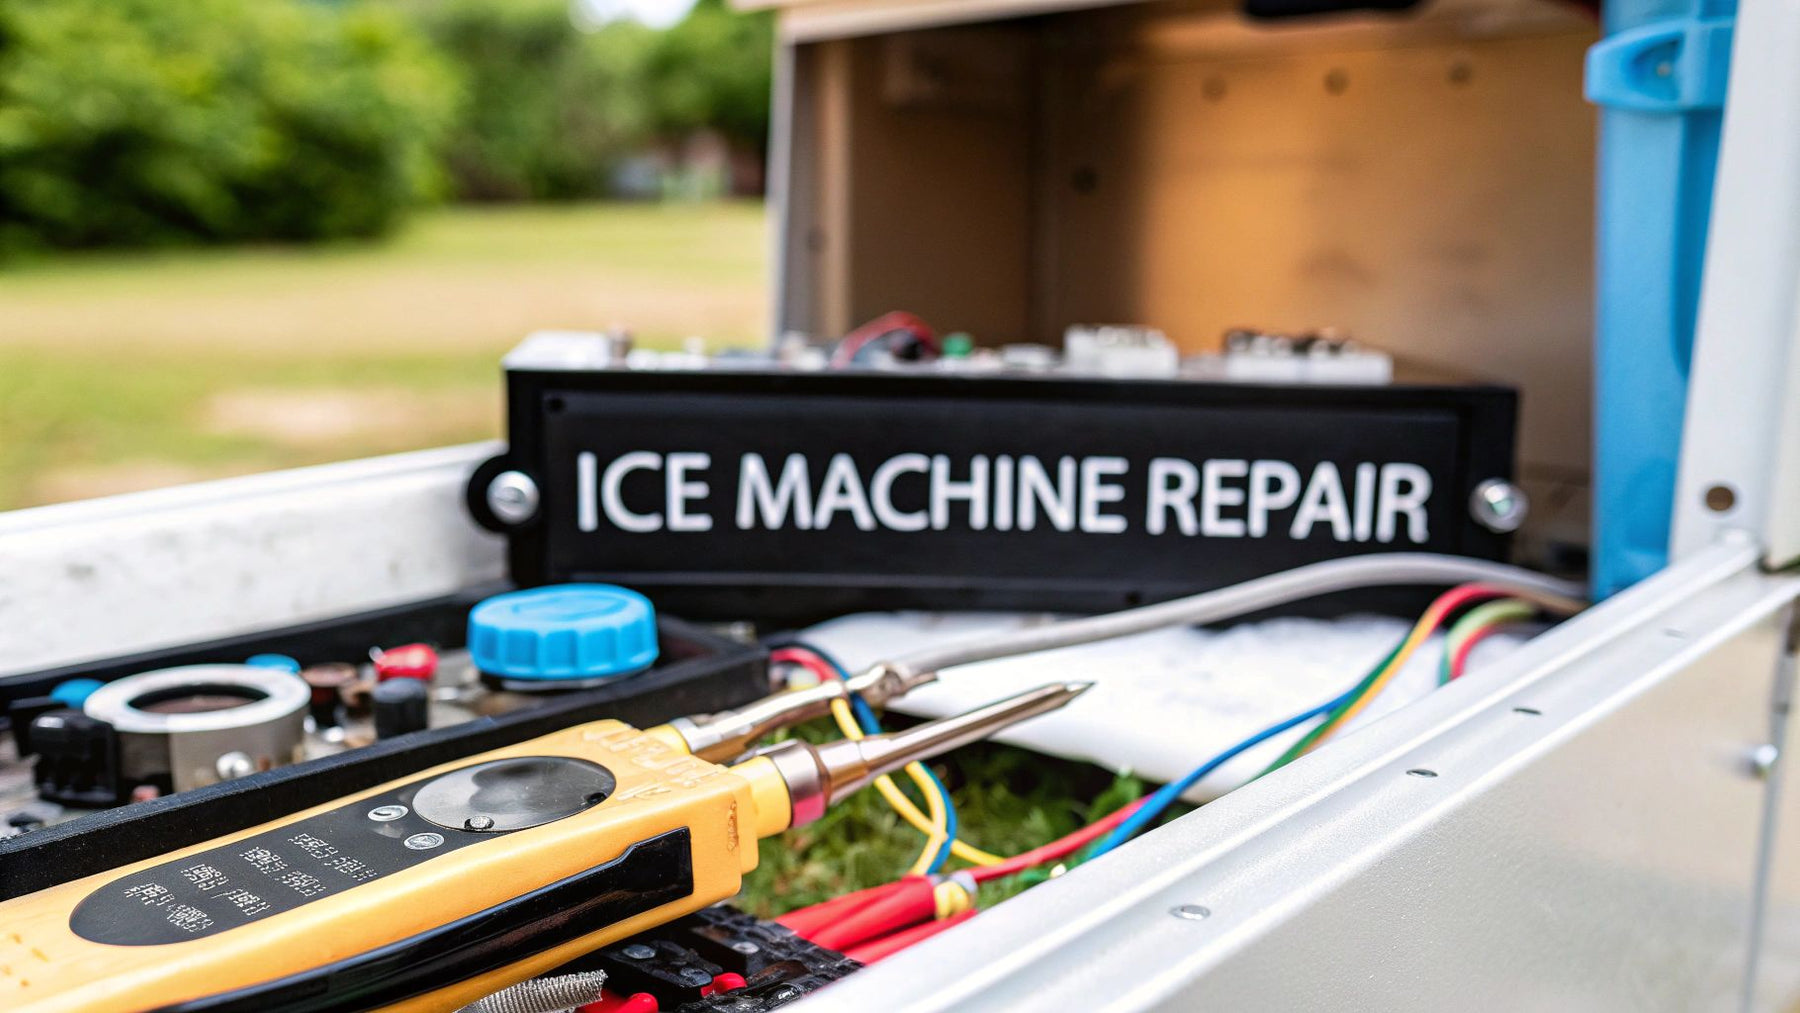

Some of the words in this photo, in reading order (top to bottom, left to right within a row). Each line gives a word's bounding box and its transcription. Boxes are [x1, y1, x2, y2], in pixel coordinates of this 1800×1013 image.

[578, 452, 712, 532] ICE
[736, 453, 1128, 533] MACHINE
[1146, 458, 1430, 542] REPAIR
